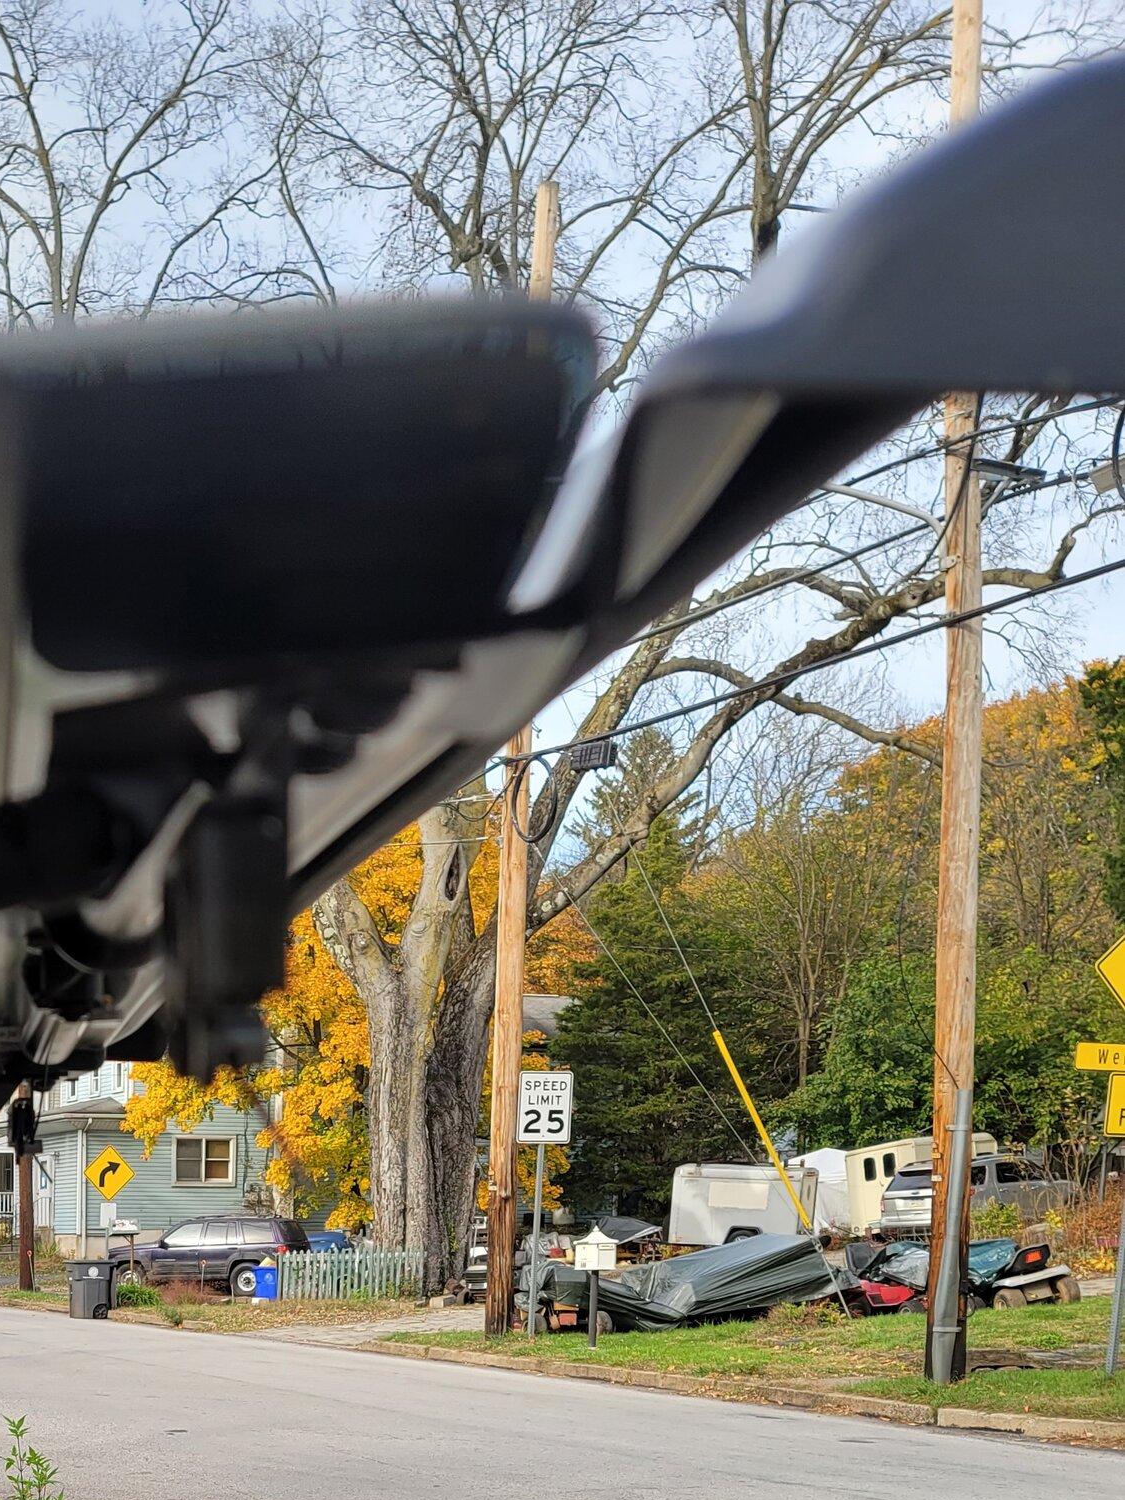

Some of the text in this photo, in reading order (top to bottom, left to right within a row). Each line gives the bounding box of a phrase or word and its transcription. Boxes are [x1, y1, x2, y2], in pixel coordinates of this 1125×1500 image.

[1098, 1048, 1125, 1065] We
[525, 1081, 567, 1091] SPEED
[528, 1095, 562, 1105] LIMIT
[523, 1109, 564, 1134] 25
